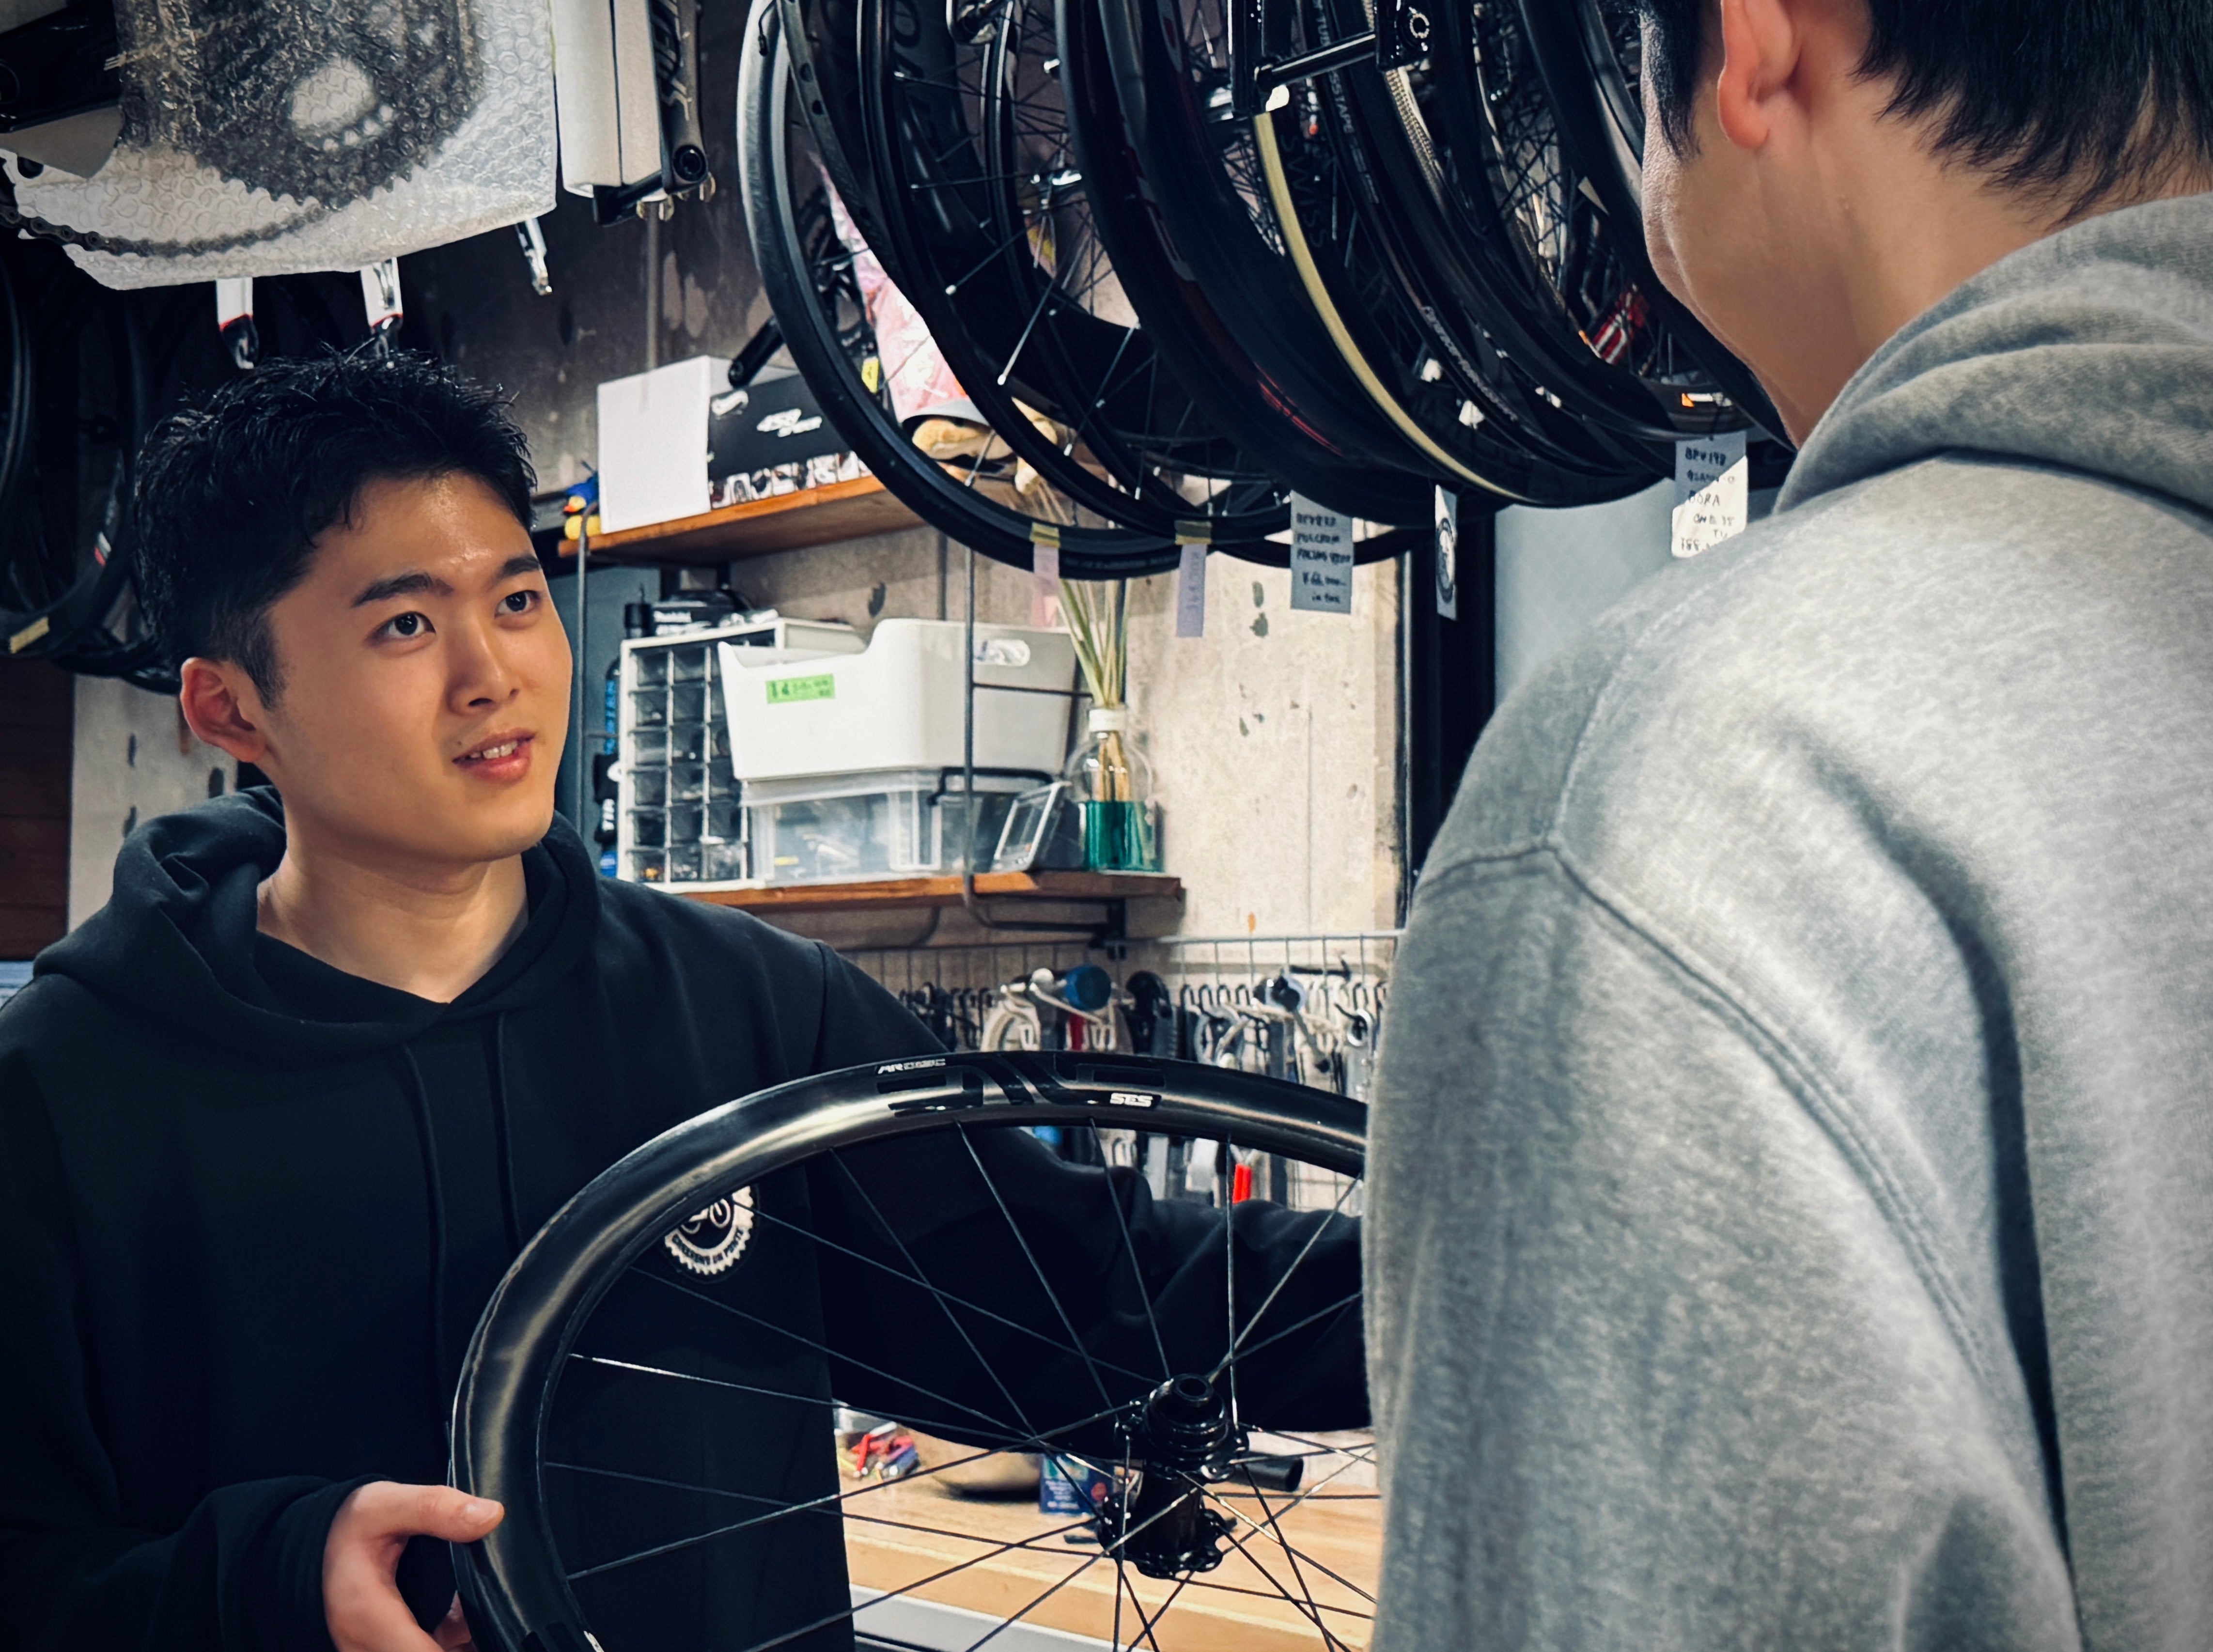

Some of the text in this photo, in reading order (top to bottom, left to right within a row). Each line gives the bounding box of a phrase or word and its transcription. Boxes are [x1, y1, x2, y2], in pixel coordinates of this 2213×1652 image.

[1335, 95, 1355, 133] TAPE
[1280, 134, 1330, 248] SWISS
[1110, 1092, 1153, 1107] SES
